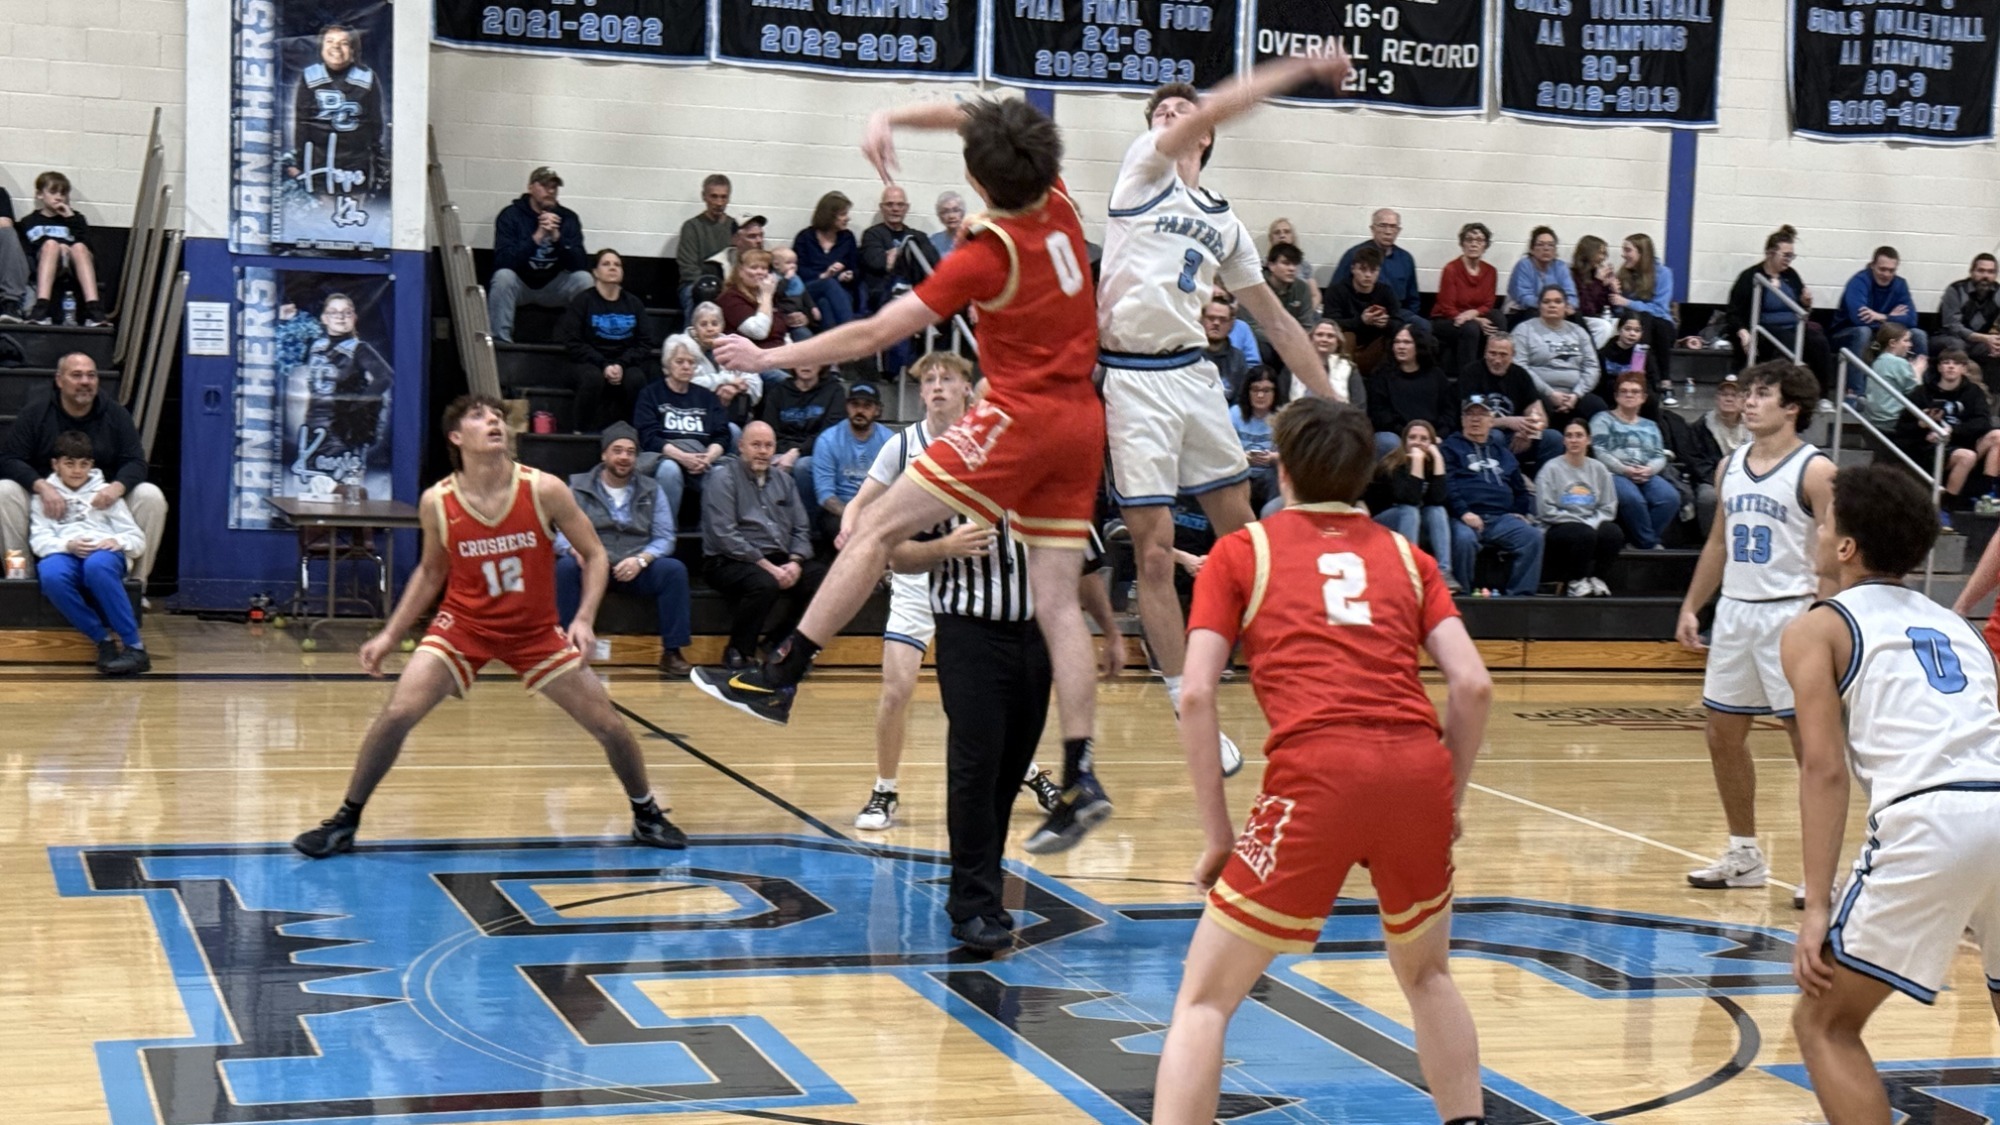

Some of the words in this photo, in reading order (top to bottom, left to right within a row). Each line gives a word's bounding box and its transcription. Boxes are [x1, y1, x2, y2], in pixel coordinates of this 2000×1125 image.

[482, 6, 663, 46] 2021-2022
[1015, 0, 1065, 22] PIAA
[1082, 0, 1143, 26] FINAL
[1160, 3, 1213, 32] FOUR
[1343, 3, 1400, 31] 16-0
[1807, 7, 1865, 36] GIRLS
[1874, 9, 1987, 42] VOLLEYBALL
[760, 24, 937, 63] 2022-2023
[1082, 25, 1152, 54] 24-6
[1258, 28, 1369, 60] OVERALL
[1381, 38, 1479, 68] RECORD
[1536, 19, 1565, 47] AA
[1581, 24, 1688, 52] CHAMPIONS
[1035, 49, 1195, 84] 2022-2023
[1581, 54, 1642, 81] 20-1
[1839, 40, 1861, 65] AA
[1872, 39, 1953, 71] CHAMPIONS
[1341, 67, 1395, 94] 21-3
[1536, 80, 1680, 112] 2012-2013
[1863, 69, 1927, 97] 20-3
[234, 0, 273, 244] PANTHERS
[1828, 99, 1961, 131] 2016-2017
[1045, 231, 1084, 297] 0
[1177, 248, 1204, 294] 3
[234, 279, 276, 519] PANTHERS
[1723, 493, 1788, 524] ANTHERS
[457, 530, 538, 558] CRUSHERS
[1733, 524, 1772, 564] 23
[481, 556, 525, 598] 12
[1316, 551, 1375, 626] 2
[1905, 626, 1969, 695] 0
